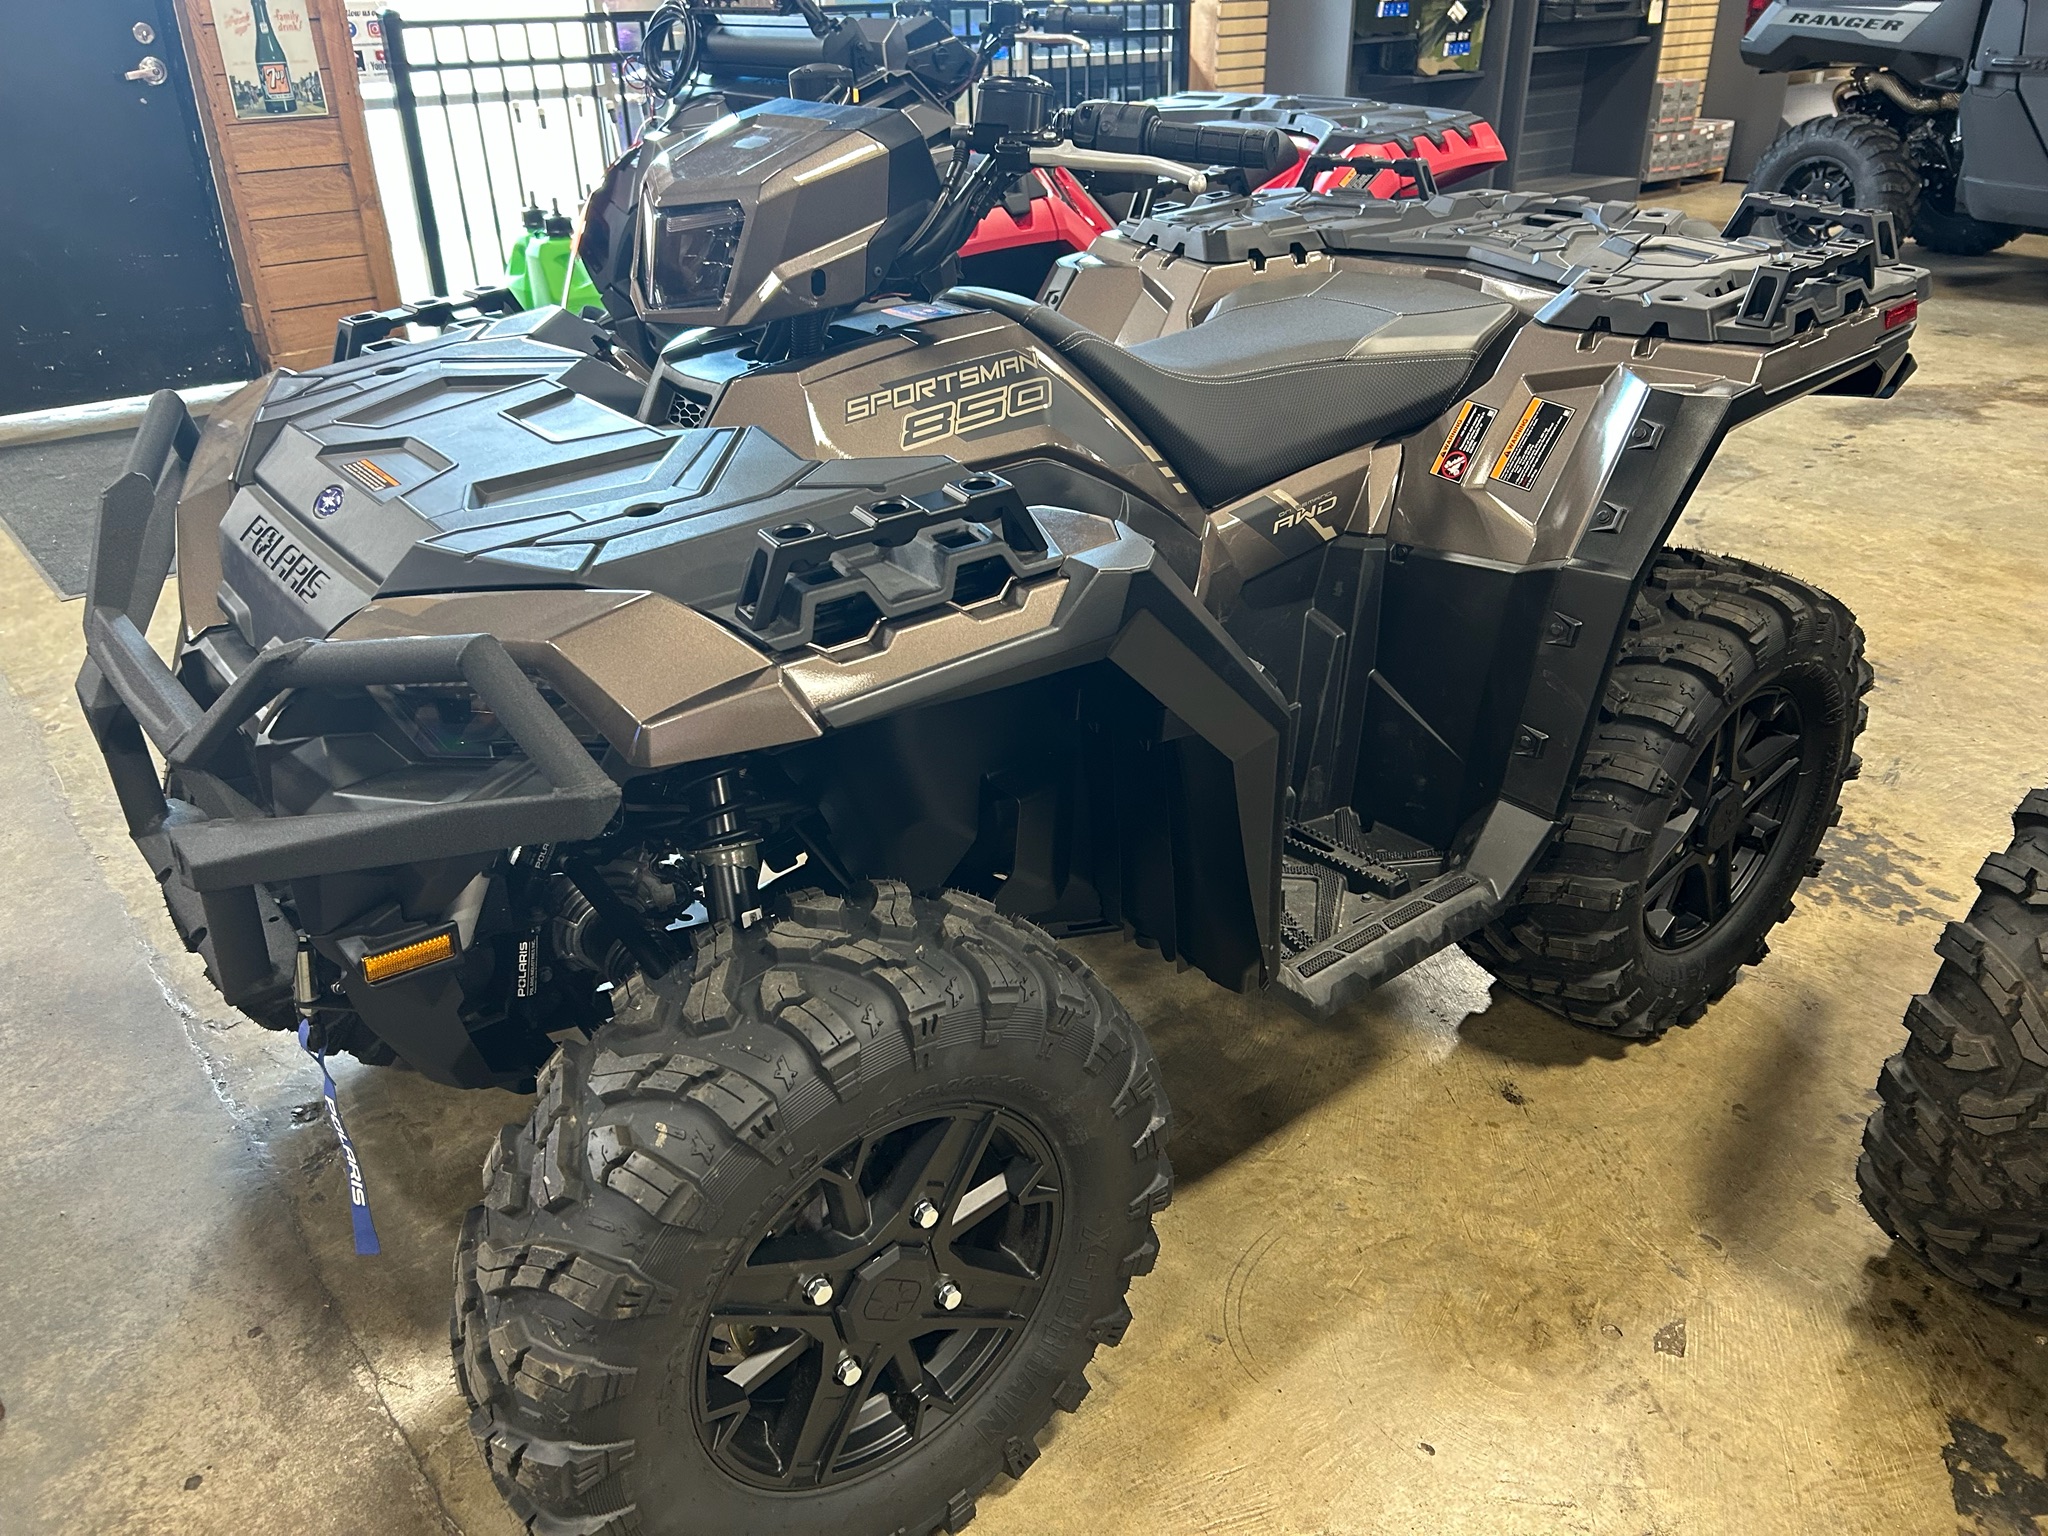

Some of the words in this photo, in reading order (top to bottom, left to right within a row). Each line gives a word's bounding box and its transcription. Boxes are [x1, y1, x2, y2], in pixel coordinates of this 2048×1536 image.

[1788, 12, 1904, 31] RANGER
[846, 352, 1039, 423] SPORTSMAN
[900, 376, 1053, 451] 850
[1443, 419, 1463, 452] WARNING
[1507, 418, 1529, 452] WARNING
[1273, 496, 1338, 535] AWD
[239, 514, 331, 605] POLARIS
[517, 941, 528, 997] POLARIS
[324, 1094, 366, 1207] POLARIS
